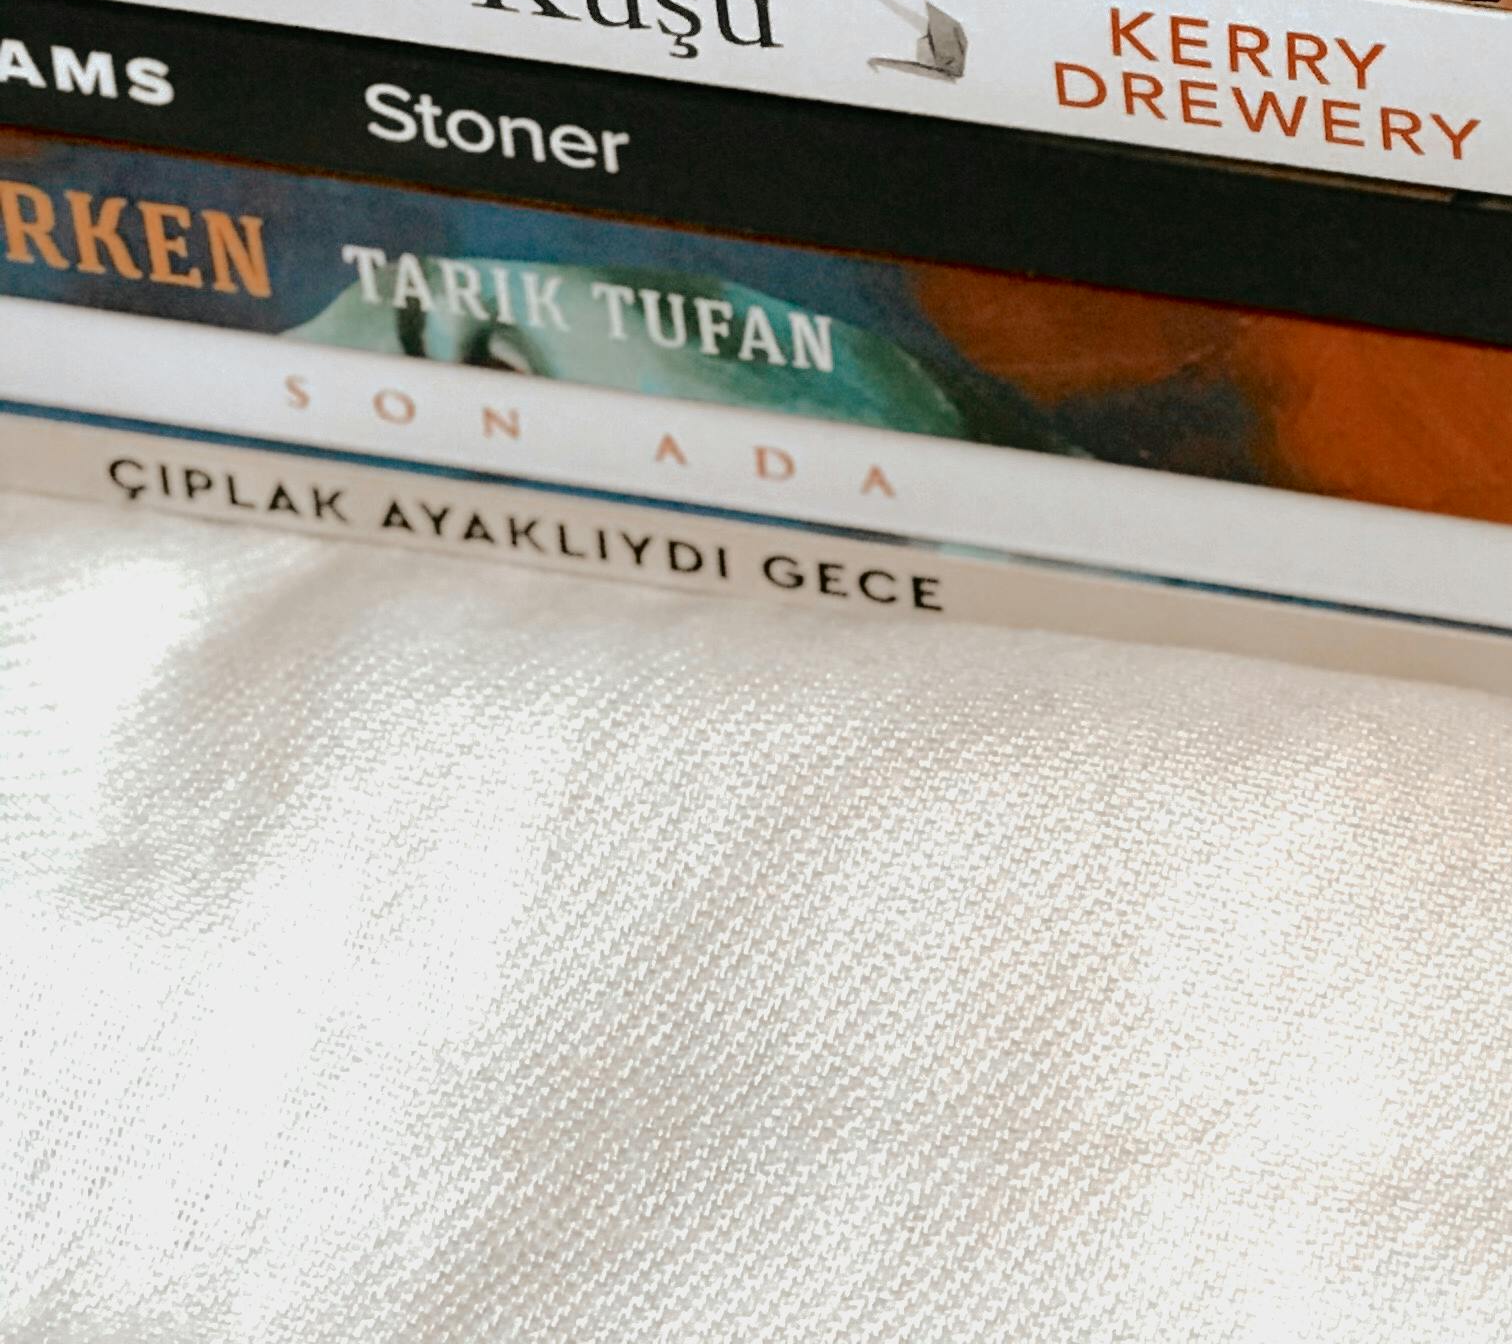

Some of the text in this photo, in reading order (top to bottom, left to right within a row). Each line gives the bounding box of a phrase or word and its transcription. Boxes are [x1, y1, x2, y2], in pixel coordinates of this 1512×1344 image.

[1109, 7, 1385, 90] KERRY
[364, 83, 631, 174] Stoner
[1055, 62, 1482, 160] DREWERY
[343, 244, 836, 374] TARIK TUFAN
[284, 374, 896, 499] SON ADA
[108, 458, 945, 612] ÇIPLAK AYAKLIYDI GECE
